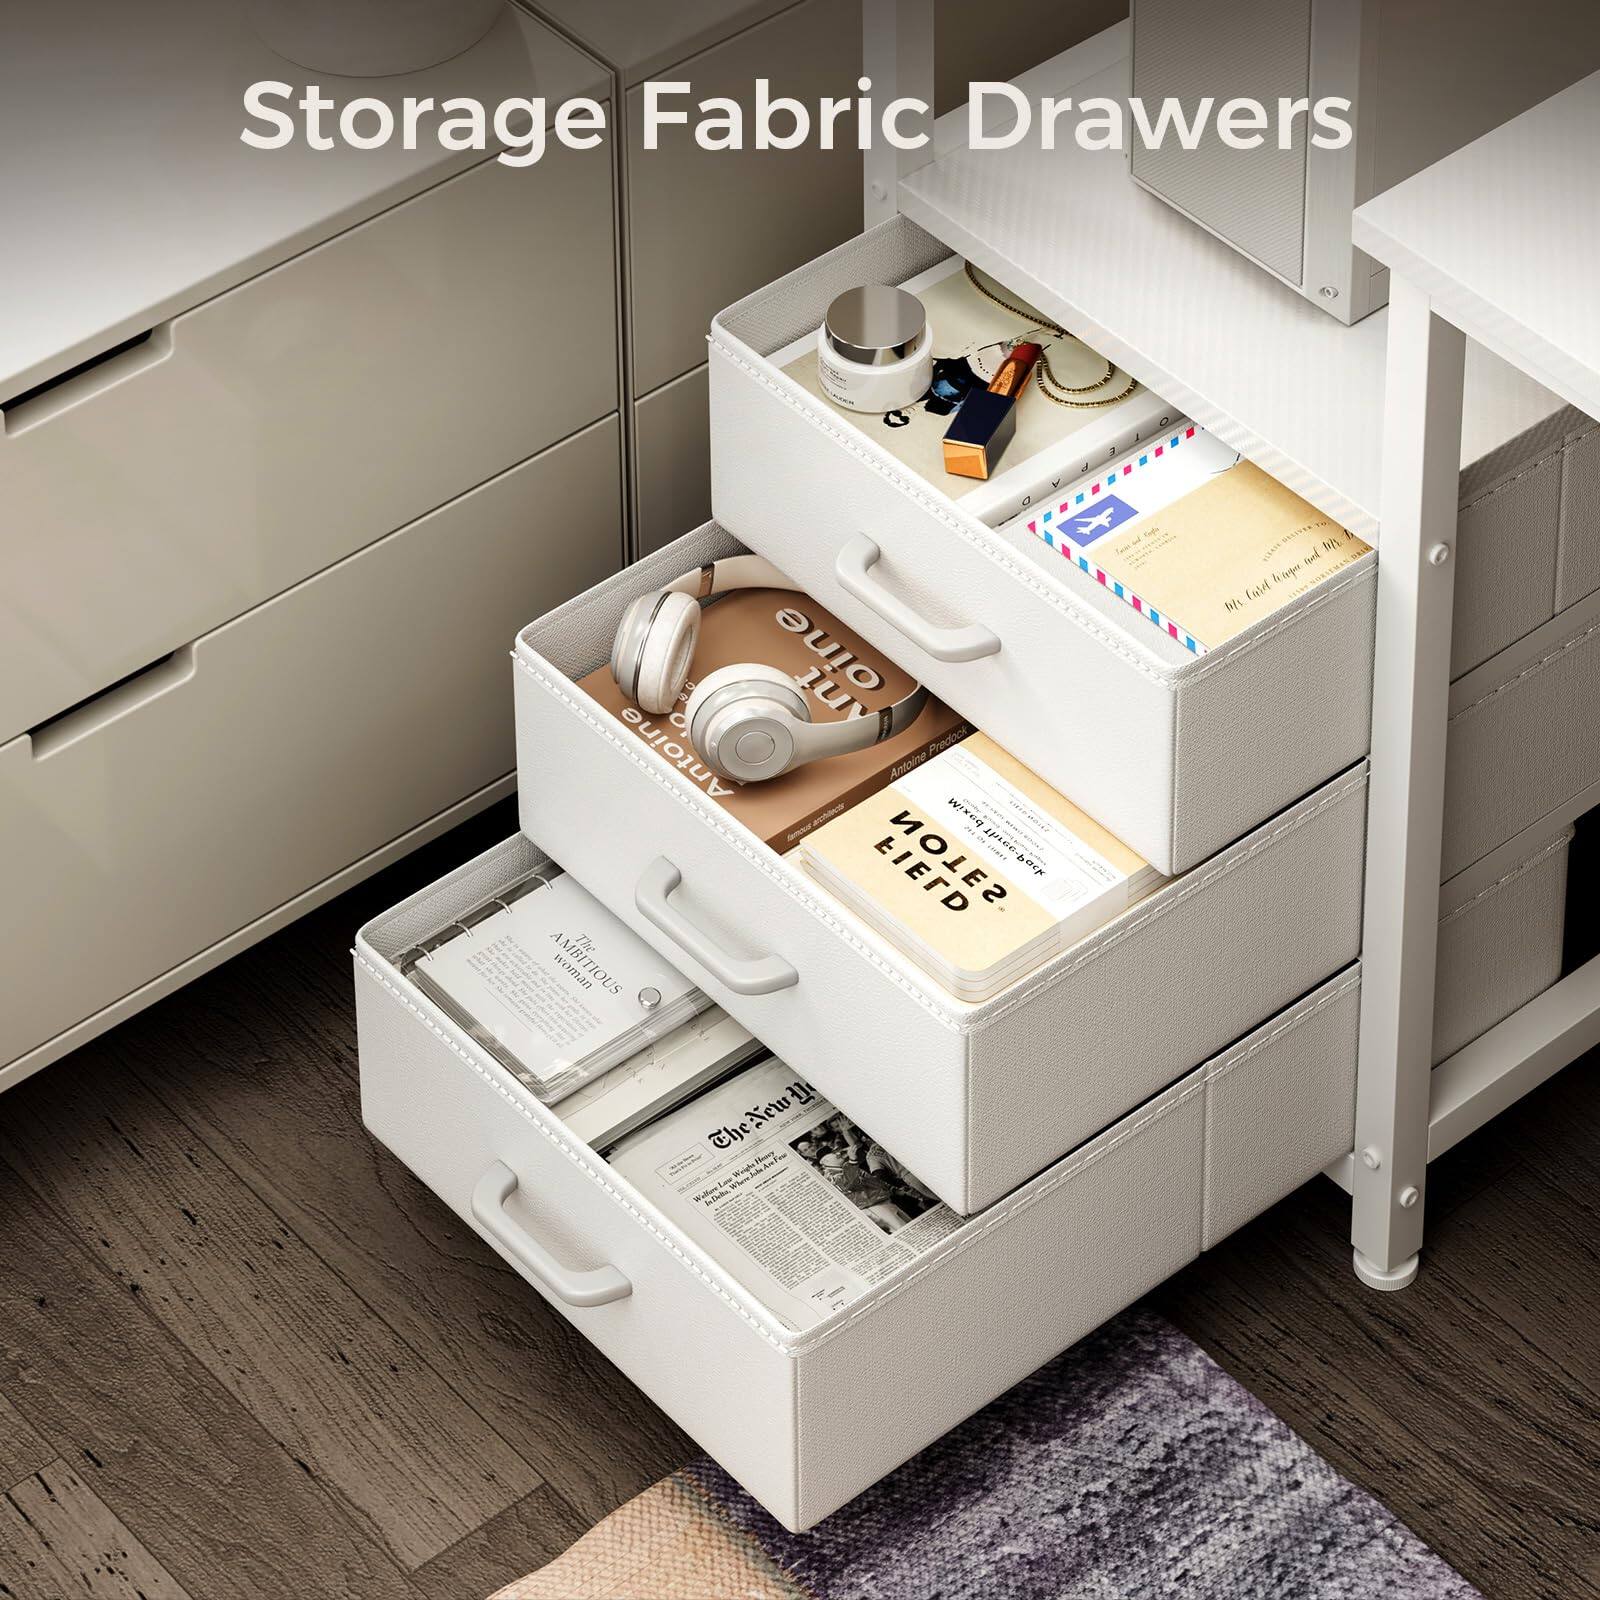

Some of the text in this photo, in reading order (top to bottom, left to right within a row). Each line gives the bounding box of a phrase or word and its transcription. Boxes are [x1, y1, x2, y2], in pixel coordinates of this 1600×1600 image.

[775, 607, 880, 689] oine
[621, 707, 735, 798] Antoine
[890, 752, 927, 781] Antoine
[929, 726, 968, 755] Predock
[787, 802, 845, 842] famous architects
[550, 932, 623, 995] AMBITIOUS
[575, 933, 596, 952] The
[553, 953, 593, 990] woman
[708, 1123, 750, 1148] The
[745, 1097, 791, 1129] New
[693, 1186, 718, 1202] Welfare
[718, 1177, 732, 1188] Law
[732, 1163, 755, 1178] Weighs
[755, 1151, 774, 1165] Heavy
[711, 1190, 731, 1201] Delta,
[729, 1176, 750, 1190] Where
[750, 1168, 763, 1179] Jobs
[763, 1161, 774, 1170] Are
[773, 1153, 787, 1163] Few
